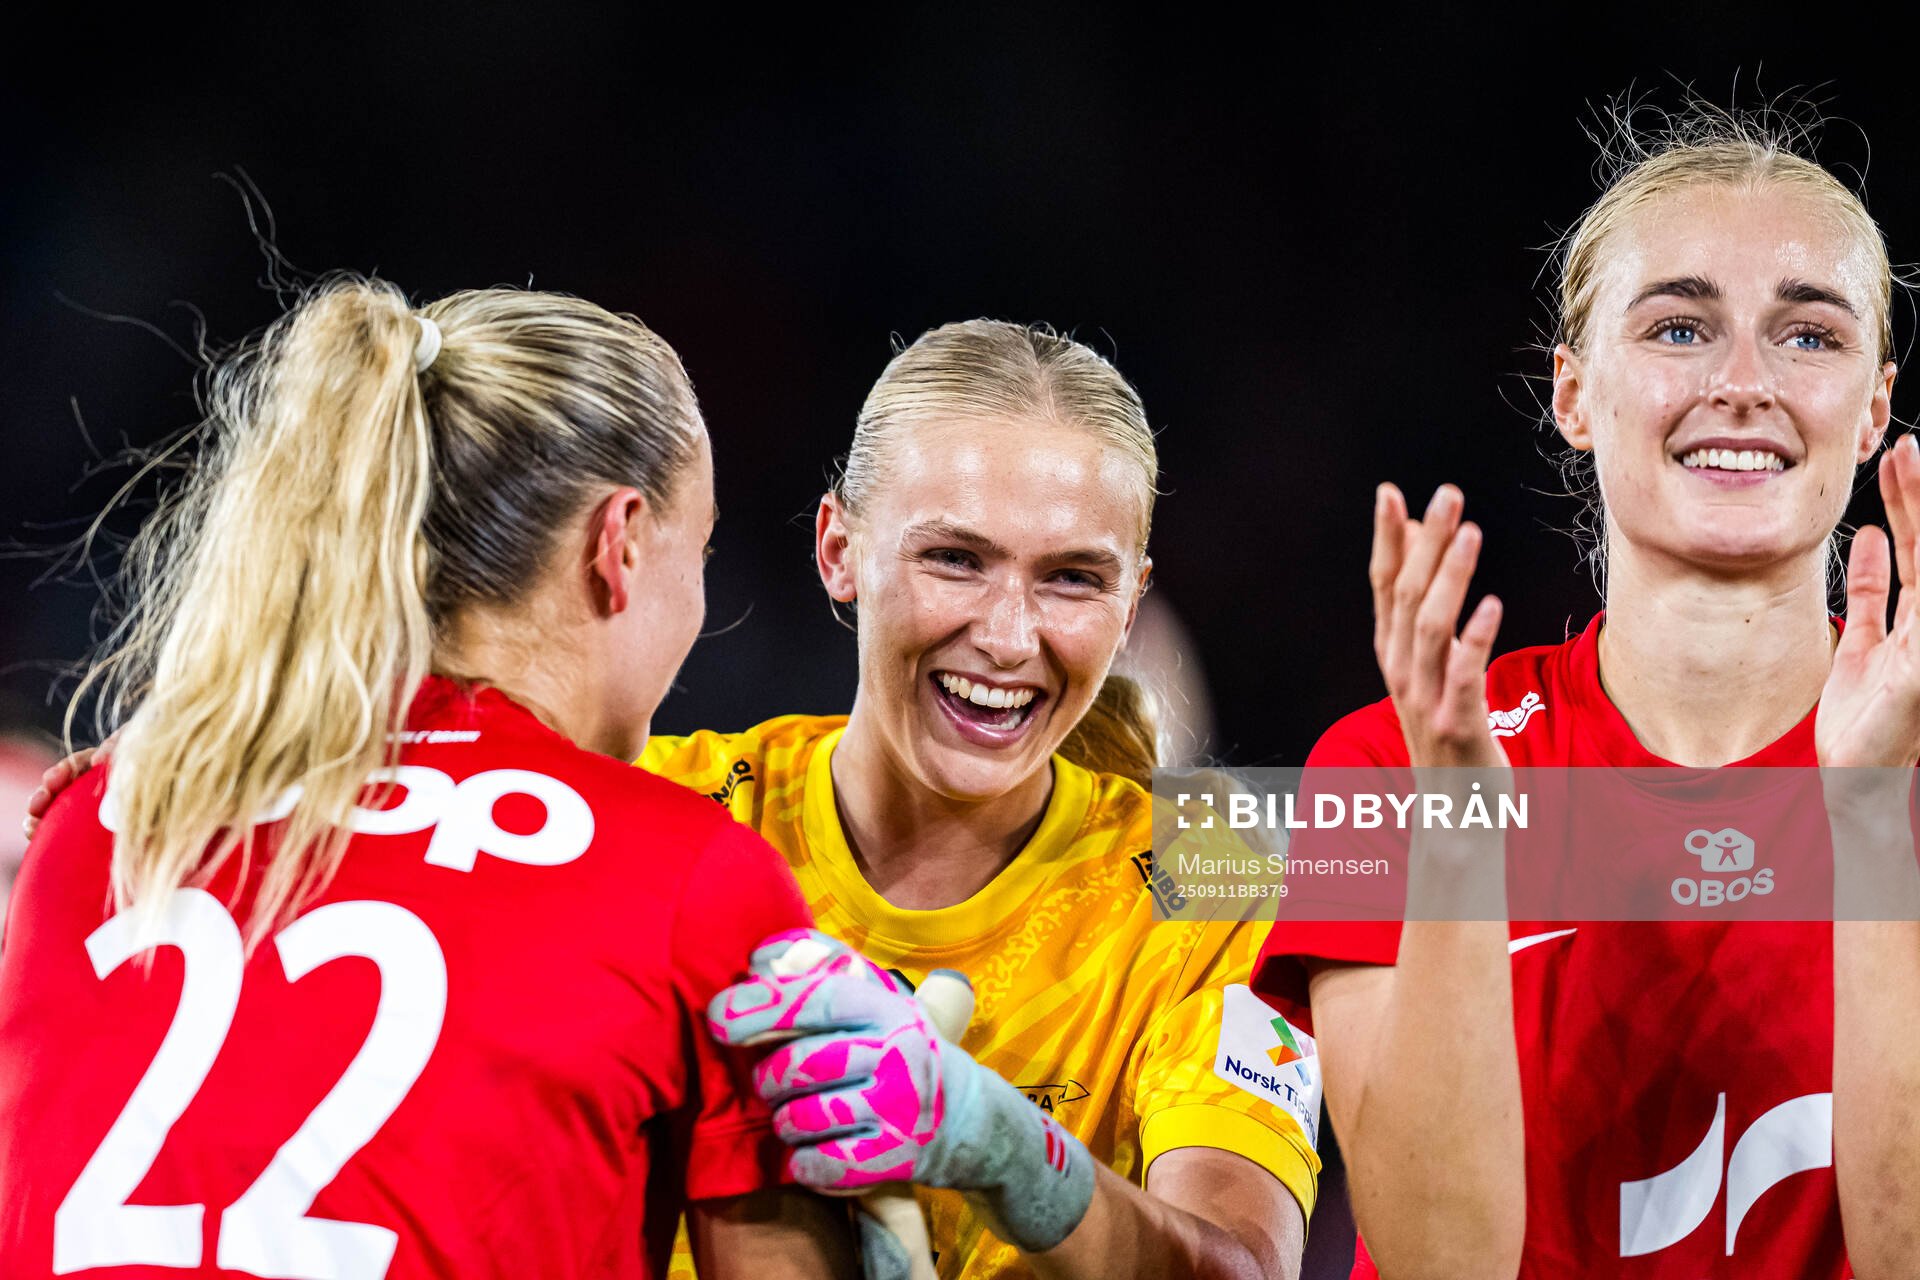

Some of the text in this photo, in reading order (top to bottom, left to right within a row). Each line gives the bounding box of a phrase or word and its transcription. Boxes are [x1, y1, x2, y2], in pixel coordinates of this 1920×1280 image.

[99, 765, 596, 873] op
[1670, 867, 1775, 908] OBOS
[52, 887, 448, 1280] 22
[1225, 1055, 1281, 1096] Norsk
